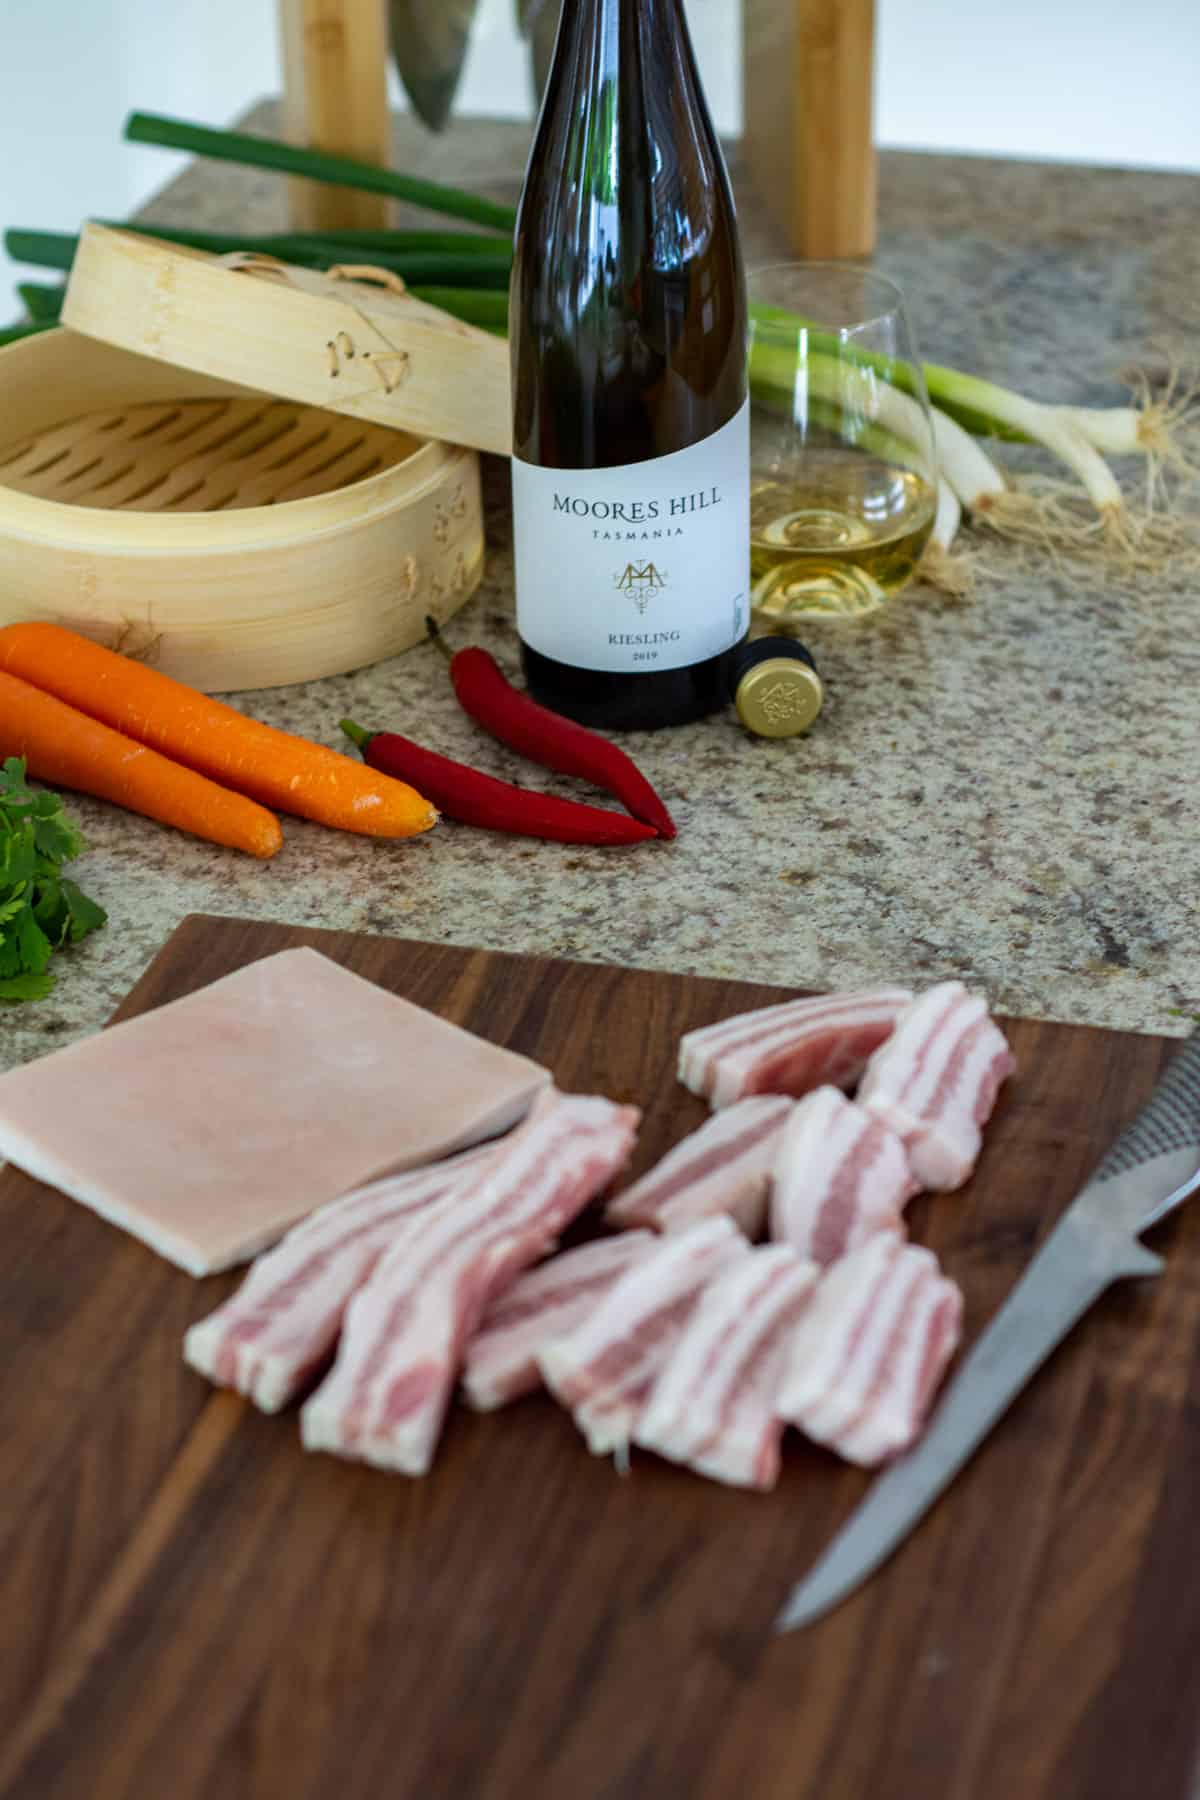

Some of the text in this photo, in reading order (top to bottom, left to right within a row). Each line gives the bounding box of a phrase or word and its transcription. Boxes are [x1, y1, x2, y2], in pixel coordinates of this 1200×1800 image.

[552, 486, 721, 524] MOORES HILL
[592, 527, 683, 540] TASMANIA
[608, 630, 680, 645] RIESLING
[632, 651, 658, 661] 2019
